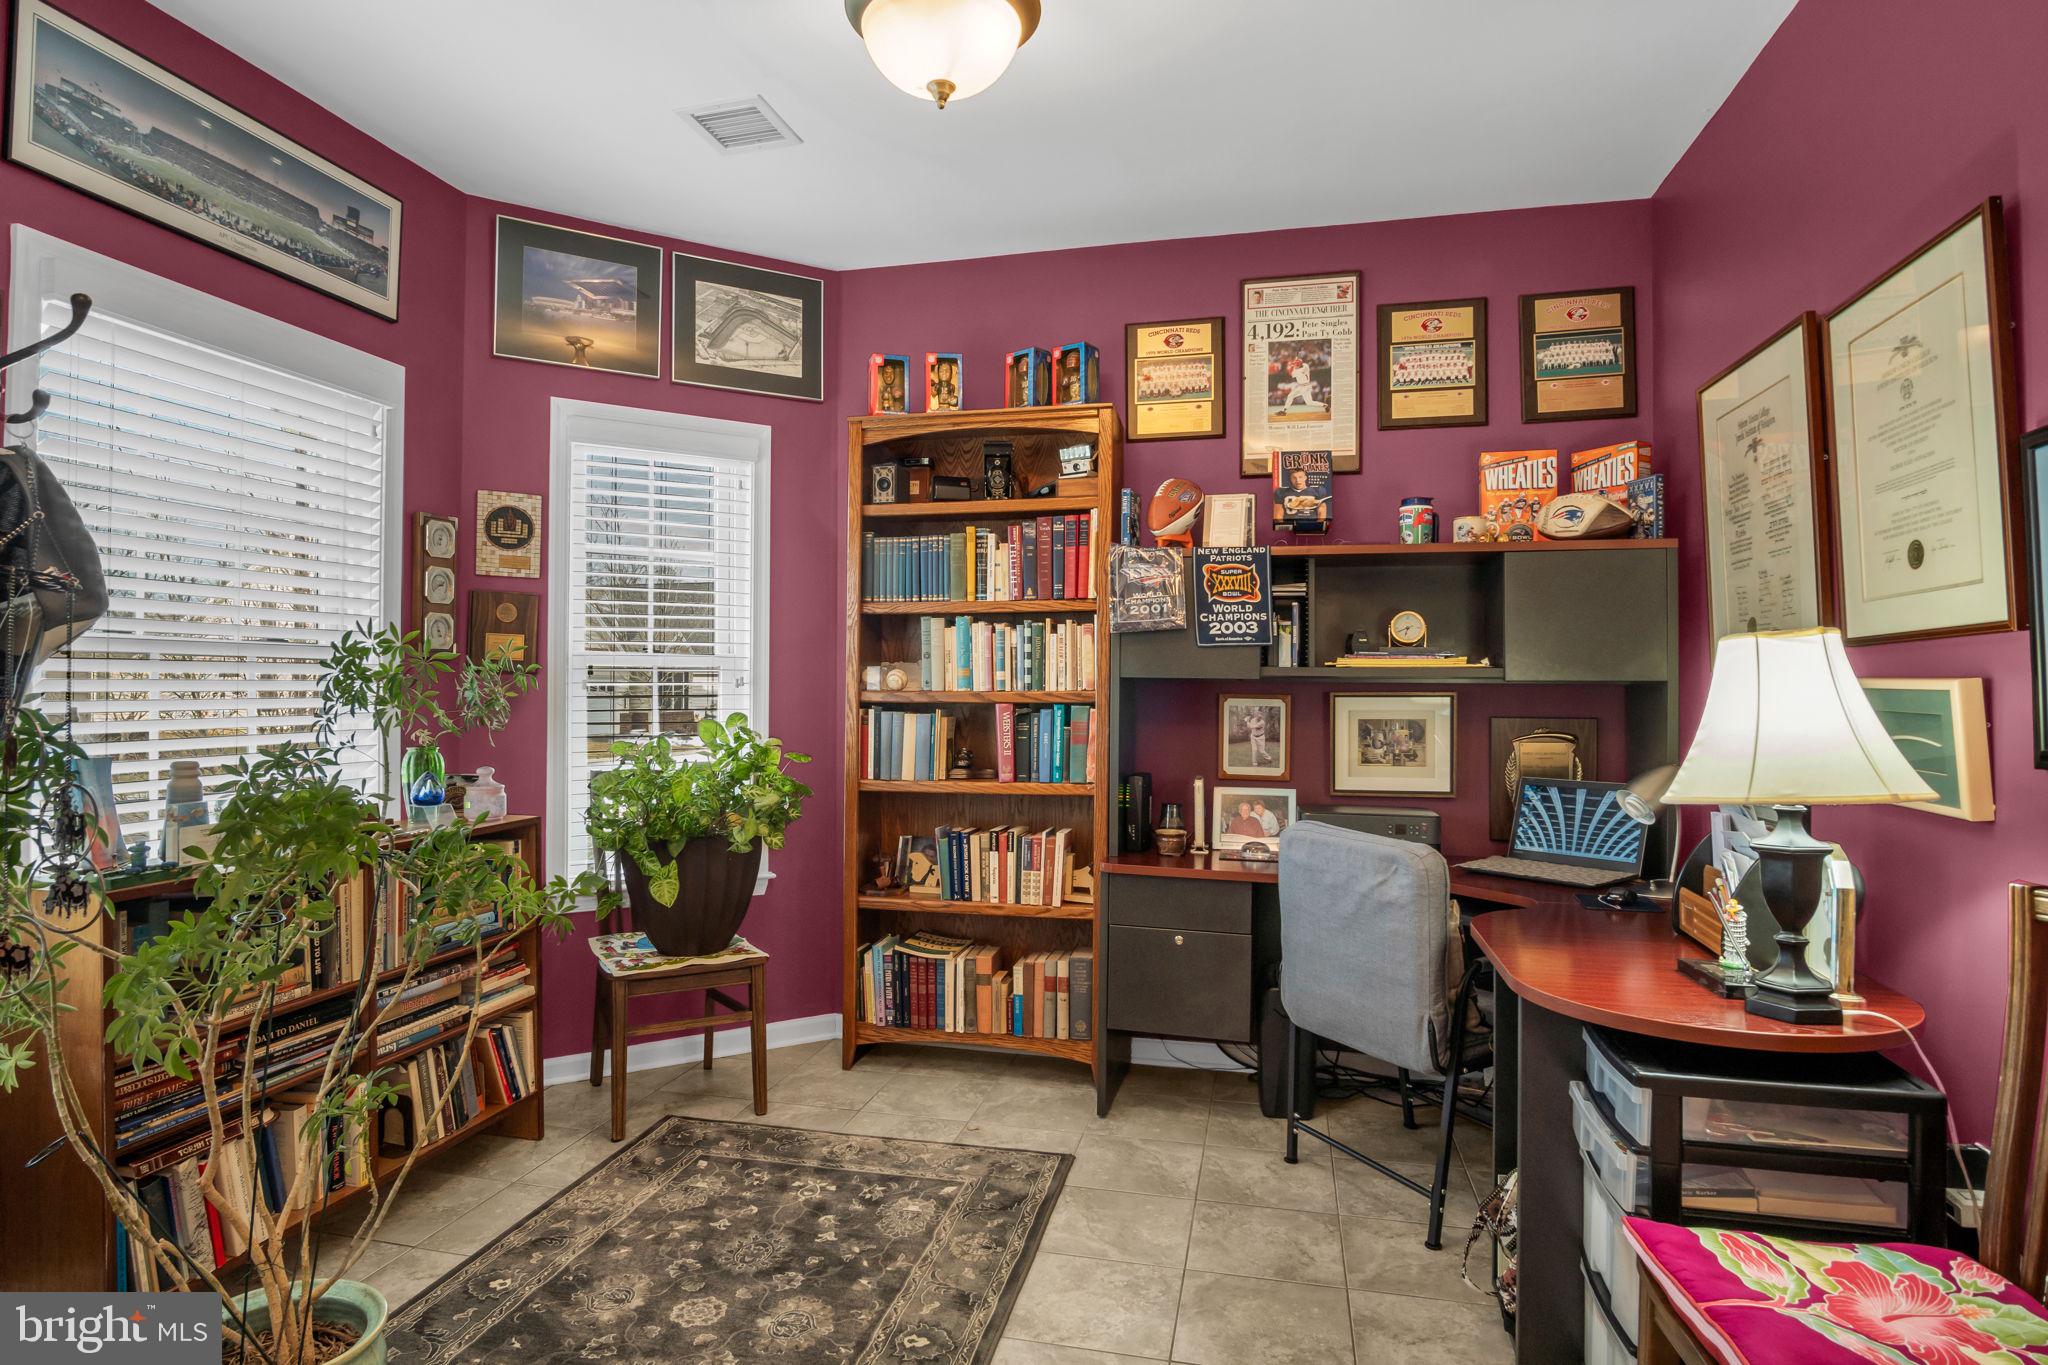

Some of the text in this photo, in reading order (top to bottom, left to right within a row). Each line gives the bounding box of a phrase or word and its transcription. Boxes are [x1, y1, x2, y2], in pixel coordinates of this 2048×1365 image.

[1255, 304, 1348, 318] THE CINCINNATI ENQUIRER
[1403, 311, 1444, 321] CINCINNATI
[1148, 327, 1201, 337] CINCINNATI REDS
[1247, 319, 1348, 342] 4,192: Pete Singles
[1302, 328, 1353, 338] Past Ty Cobb
[1302, 463, 1330, 473] FLAKES
[1484, 456, 1558, 491] WHEATIES
[1573, 452, 1635, 493] WHEATIES
[1010, 543, 1018, 584] TRUTH
[1211, 572, 1252, 594] XXXVIII
[1124, 597, 1171, 605] CHAMPIONS
[1130, 603, 1169, 615] 2001
[1212, 604, 1253, 613] WORLD
[1199, 612, 1268, 622] CHAMPIONS
[1208, 621, 1259, 635] 2003
[314, 946, 321, 958] TO
[314, 959, 322, 976] LIVE
[276, 1028, 287, 1037] TO
[288, 1017, 319, 1033] DANIEL
[122, 1082, 189, 1111] BIBLE TIMES
